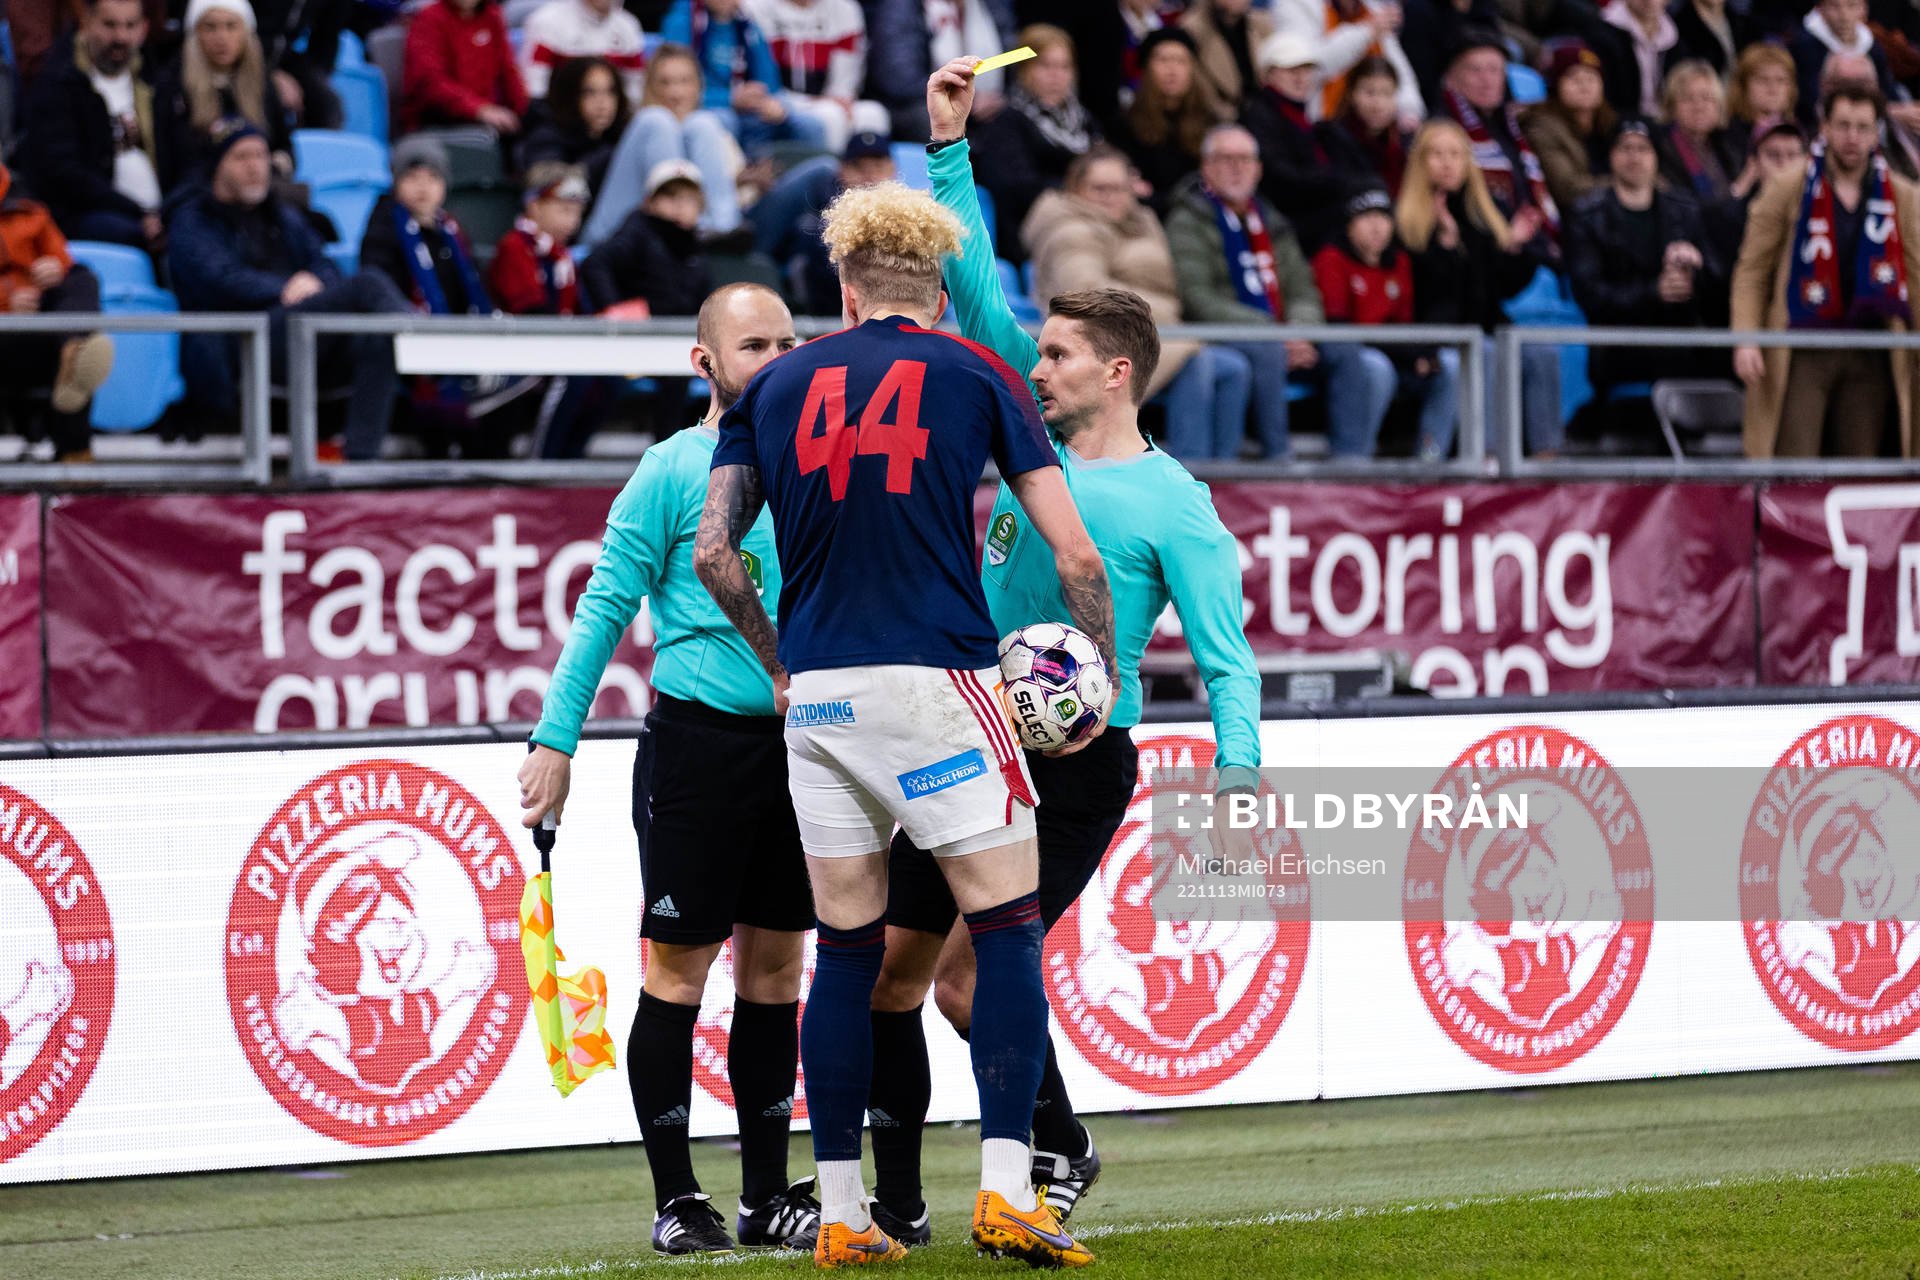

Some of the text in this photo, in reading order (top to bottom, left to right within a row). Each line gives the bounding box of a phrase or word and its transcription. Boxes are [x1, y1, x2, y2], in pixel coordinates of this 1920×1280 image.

[795, 359, 931, 502] 44
[241, 510, 652, 660] facto
[1240, 497, 1614, 669] toring
[1013, 690, 1055, 745] SELECT
[248, 770, 514, 901] PIZZERIA MUMS
[917, 782, 929, 793] AB
[1557, 743, 1636, 846] MUMS
[1755, 723, 1878, 839] PIZZERIA
